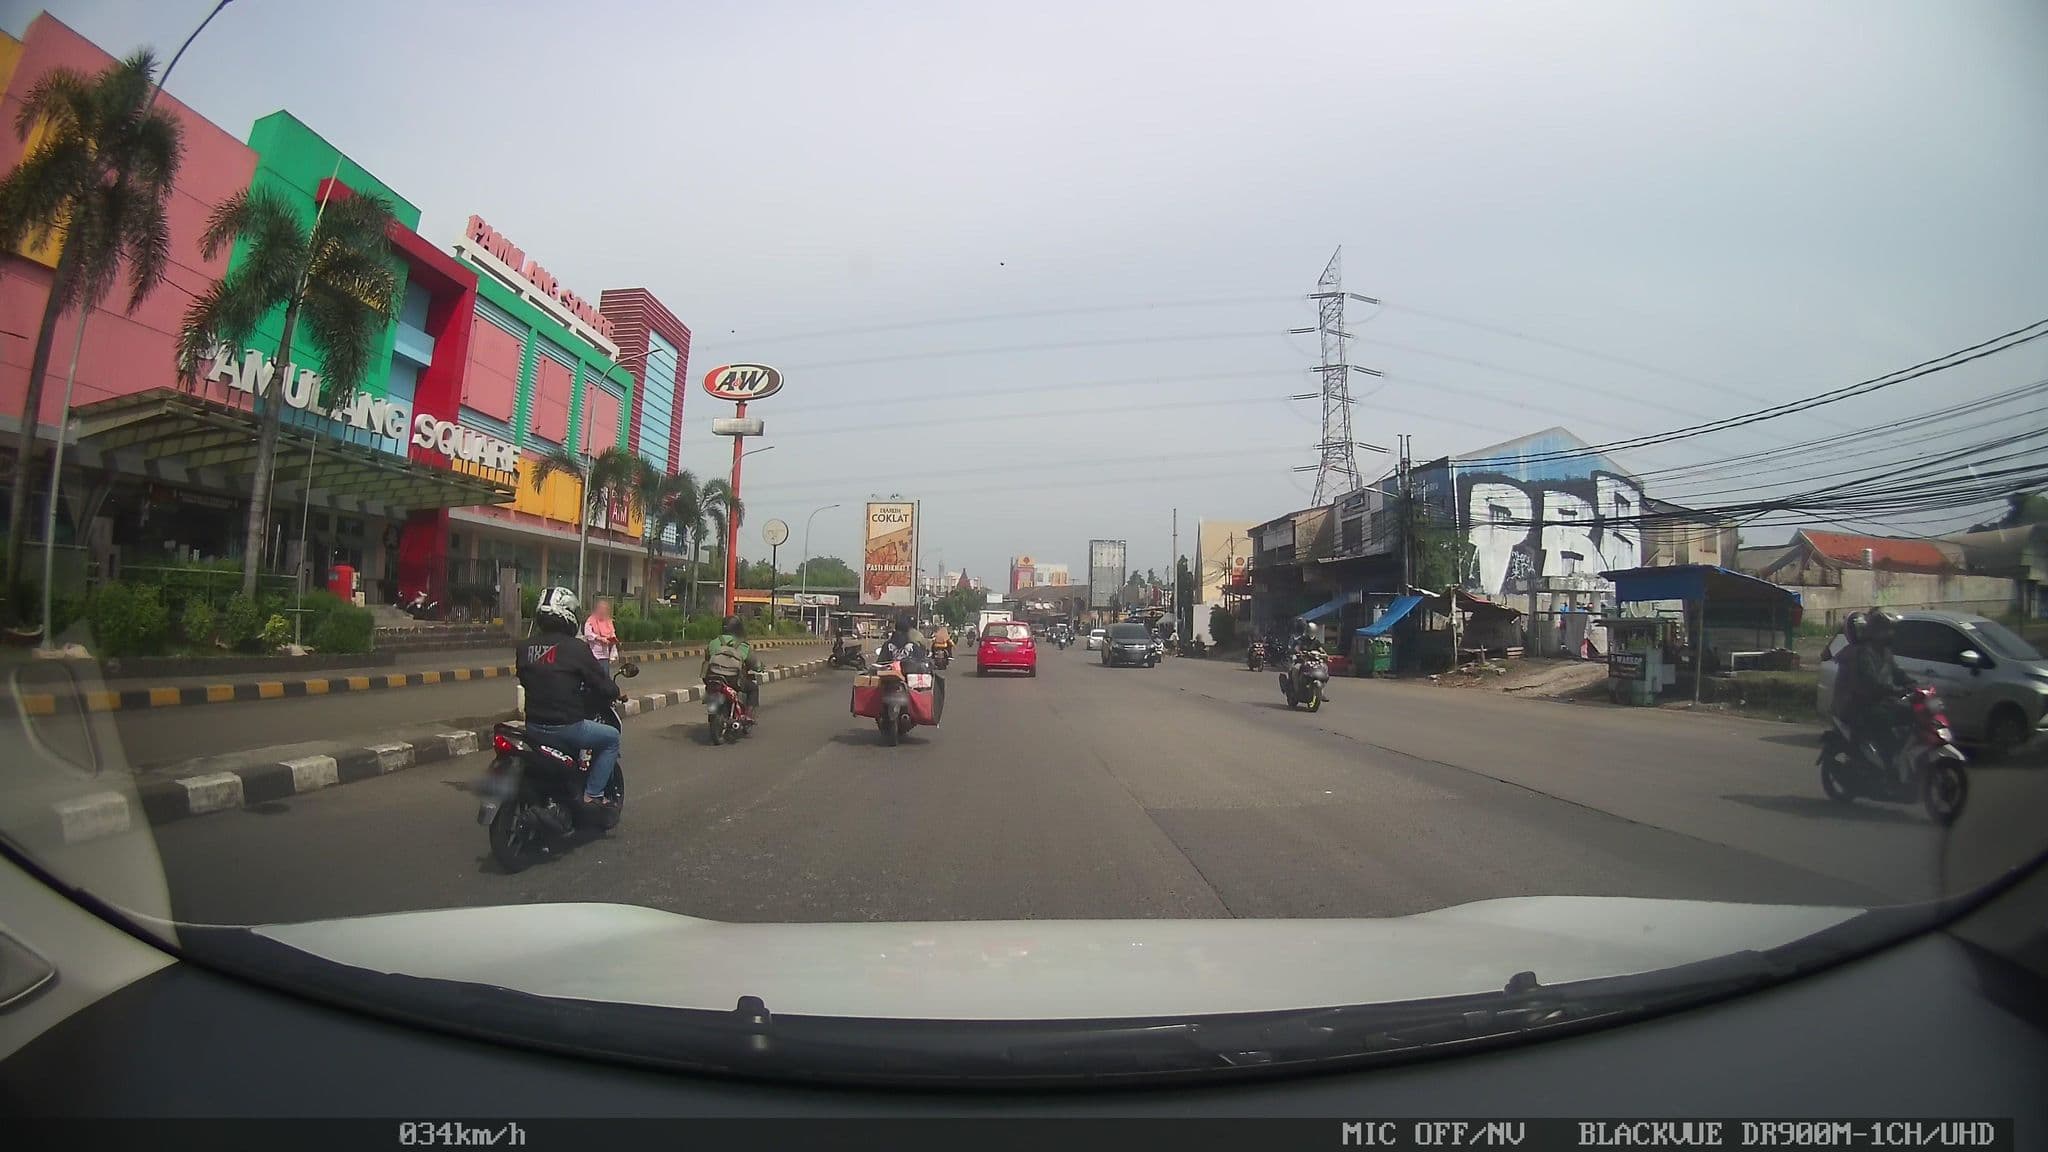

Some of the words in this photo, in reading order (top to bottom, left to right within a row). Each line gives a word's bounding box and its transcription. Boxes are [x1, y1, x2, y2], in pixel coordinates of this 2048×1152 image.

[466, 215, 559, 301] PAMULANG
[560, 290, 615, 342] SQUARE
[715, 370, 769, 392] A&W
[412, 414, 521, 474] SQUARE
[871, 513, 909, 523] COKLAT
